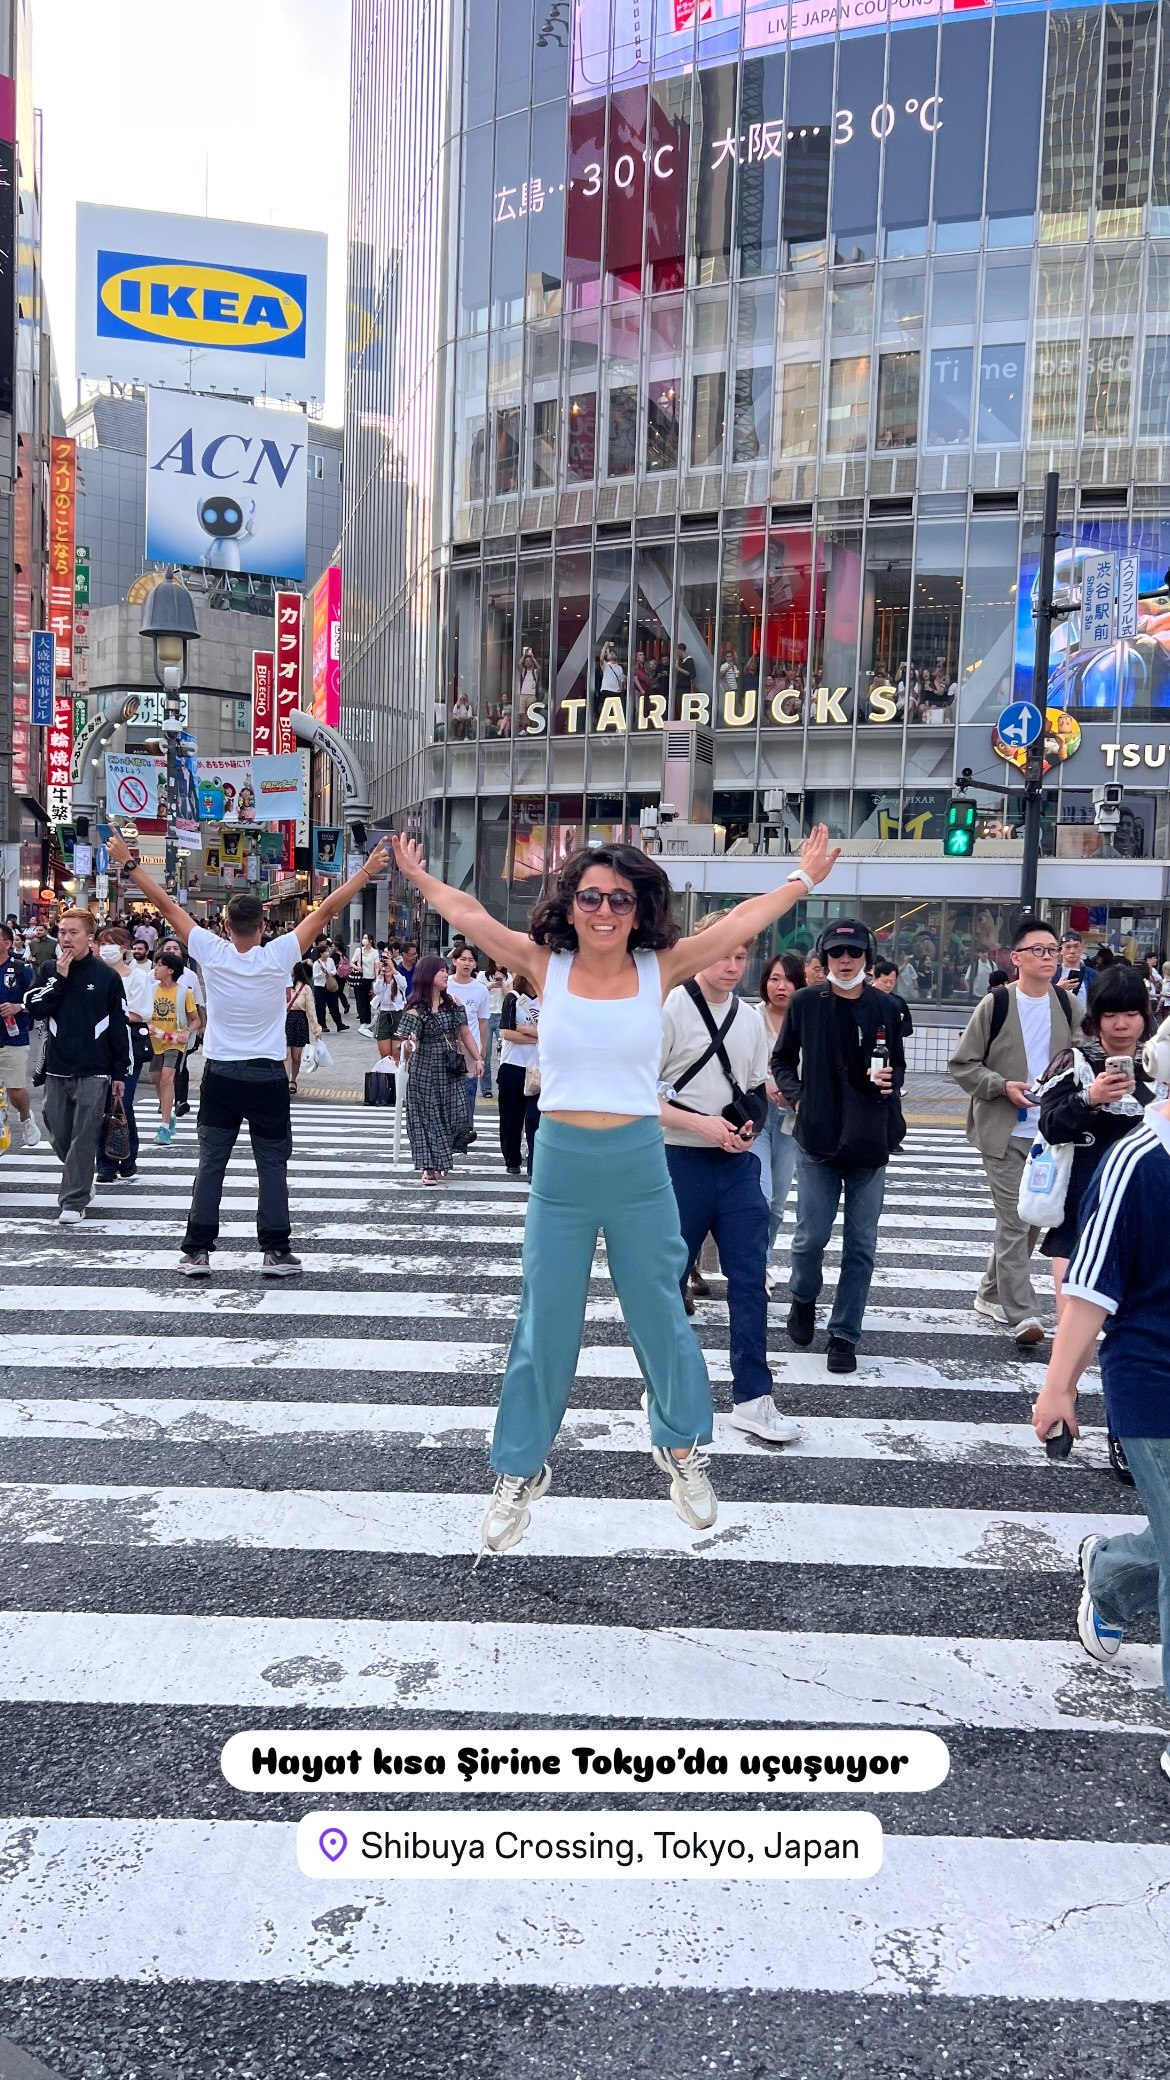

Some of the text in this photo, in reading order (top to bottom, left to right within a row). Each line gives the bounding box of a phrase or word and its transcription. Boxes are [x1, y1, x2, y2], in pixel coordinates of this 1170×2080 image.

[767, 15, 798, 34] LIVE
[801, 7, 850, 27] JAPAN
[120, 279, 289, 331] IKEA
[150, 427, 305, 489] ACN
[50, 443, 72, 667] クスリのことなら 三千里
[1084, 575, 1094, 631] Shibuya Sta
[1094, 561, 1111, 641] 渋谷駅前
[1121, 559, 1134, 636] スクランブル式
[36, 636, 51, 720] 大盛堂商事ビル
[278, 606, 299, 706] カラオケ
[257, 664, 267, 717] BIG ECHO
[525, 685, 897, 735] STARBUCKS
[50, 714, 70, 785] 七輪焼肉
[71, 715, 102, 781] 渋谷センター街
[317, 732, 353, 794] 渋谷センター街
[1101, 743, 1170, 768] TSU
[51, 787, 68, 821] 牛繁
[905, 796, 936, 804] PIXAR
